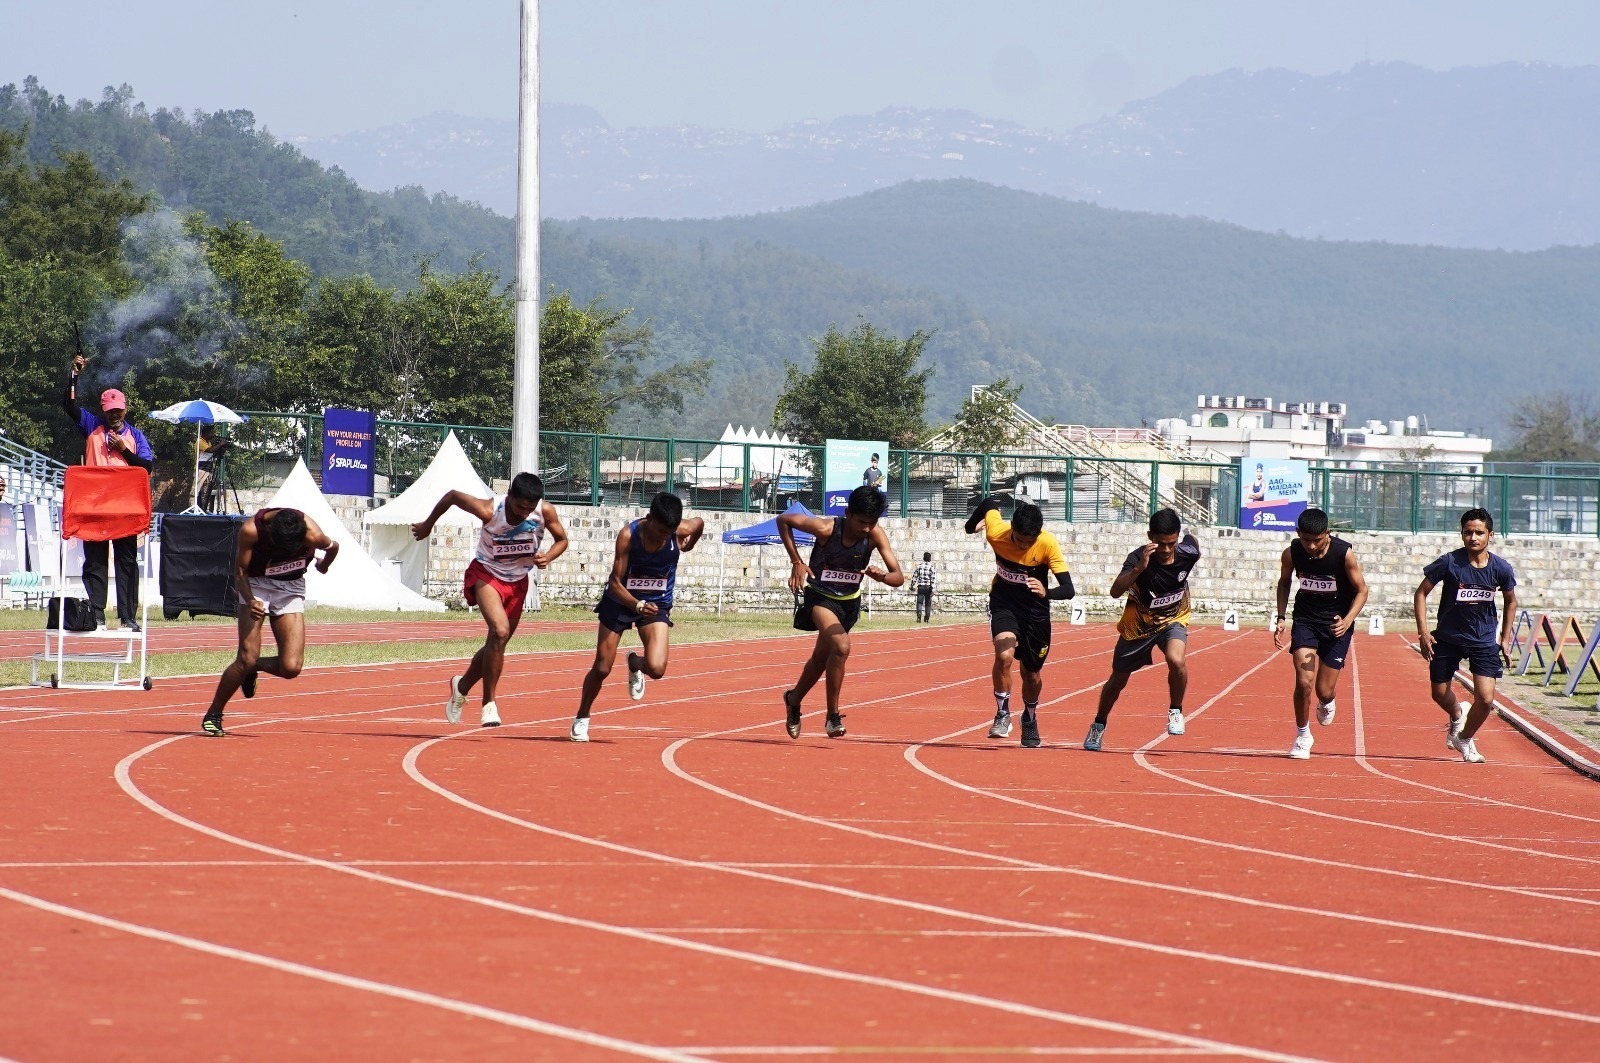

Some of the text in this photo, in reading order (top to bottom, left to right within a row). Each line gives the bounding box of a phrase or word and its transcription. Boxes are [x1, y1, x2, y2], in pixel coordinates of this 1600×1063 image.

[352, 432, 371, 440] ATHLETE
[335, 439, 362, 448] PROFILE ON
[1268, 482, 1302, 491] MAIDAAN
[1262, 512, 1276, 520] SFA
[496, 544, 531, 553] 23906
[268, 561, 302, 574] 52609
[824, 571, 858, 581] 23860
[630, 579, 663, 587] 52578
[1301, 579, 1333, 589] 47197
[1460, 590, 1491, 599] 60249
[1074, 608, 1083, 621] 7
[1225, 614, 1236, 625] 4
[1373, 618, 1379, 629] 1
